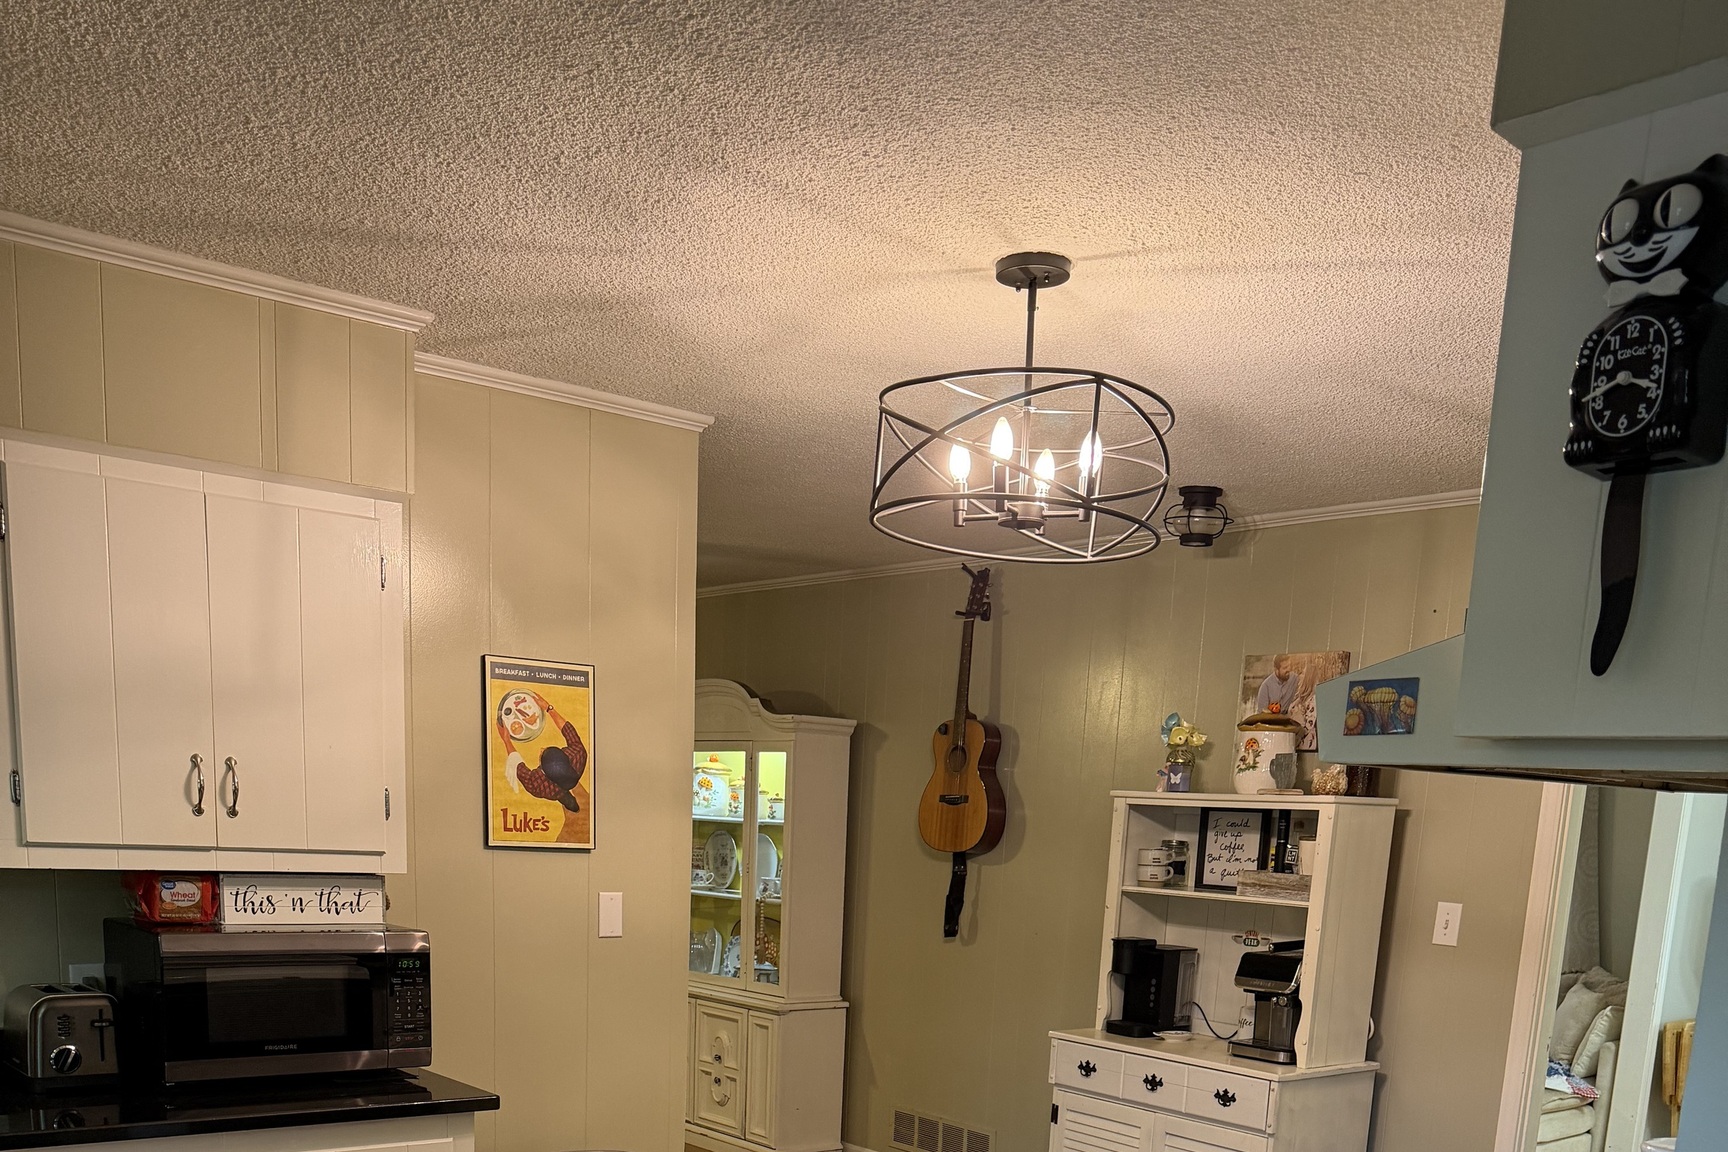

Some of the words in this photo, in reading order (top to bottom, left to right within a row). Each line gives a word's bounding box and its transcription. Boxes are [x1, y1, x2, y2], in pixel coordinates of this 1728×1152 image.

[1626, 322, 1640, 339] 12
[1649, 327, 1655, 342] 1
[1610, 335, 1620, 351] 11
[1652, 344, 1662, 360] 2
[1600, 354, 1614, 371] 10
[1650, 364, 1660, 380] 3
[1646, 386, 1657, 399] 4
[1594, 395, 1604, 410] 8
[1602, 410, 1612, 426] 7
[1636, 403, 1647, 419] 5
[1617, 414, 1628, 429] 6
[495, 667, 530, 677] BREAKFAST
[535, 672, 557, 680] LUNCH
[562, 674, 585, 682] DINNER
[1226, 818, 1251, 828] could
[1230, 831, 1243, 842] up
[169, 891, 196, 899] Wheat
[229, 884, 283, 916] this
[314, 884, 379, 916] that
